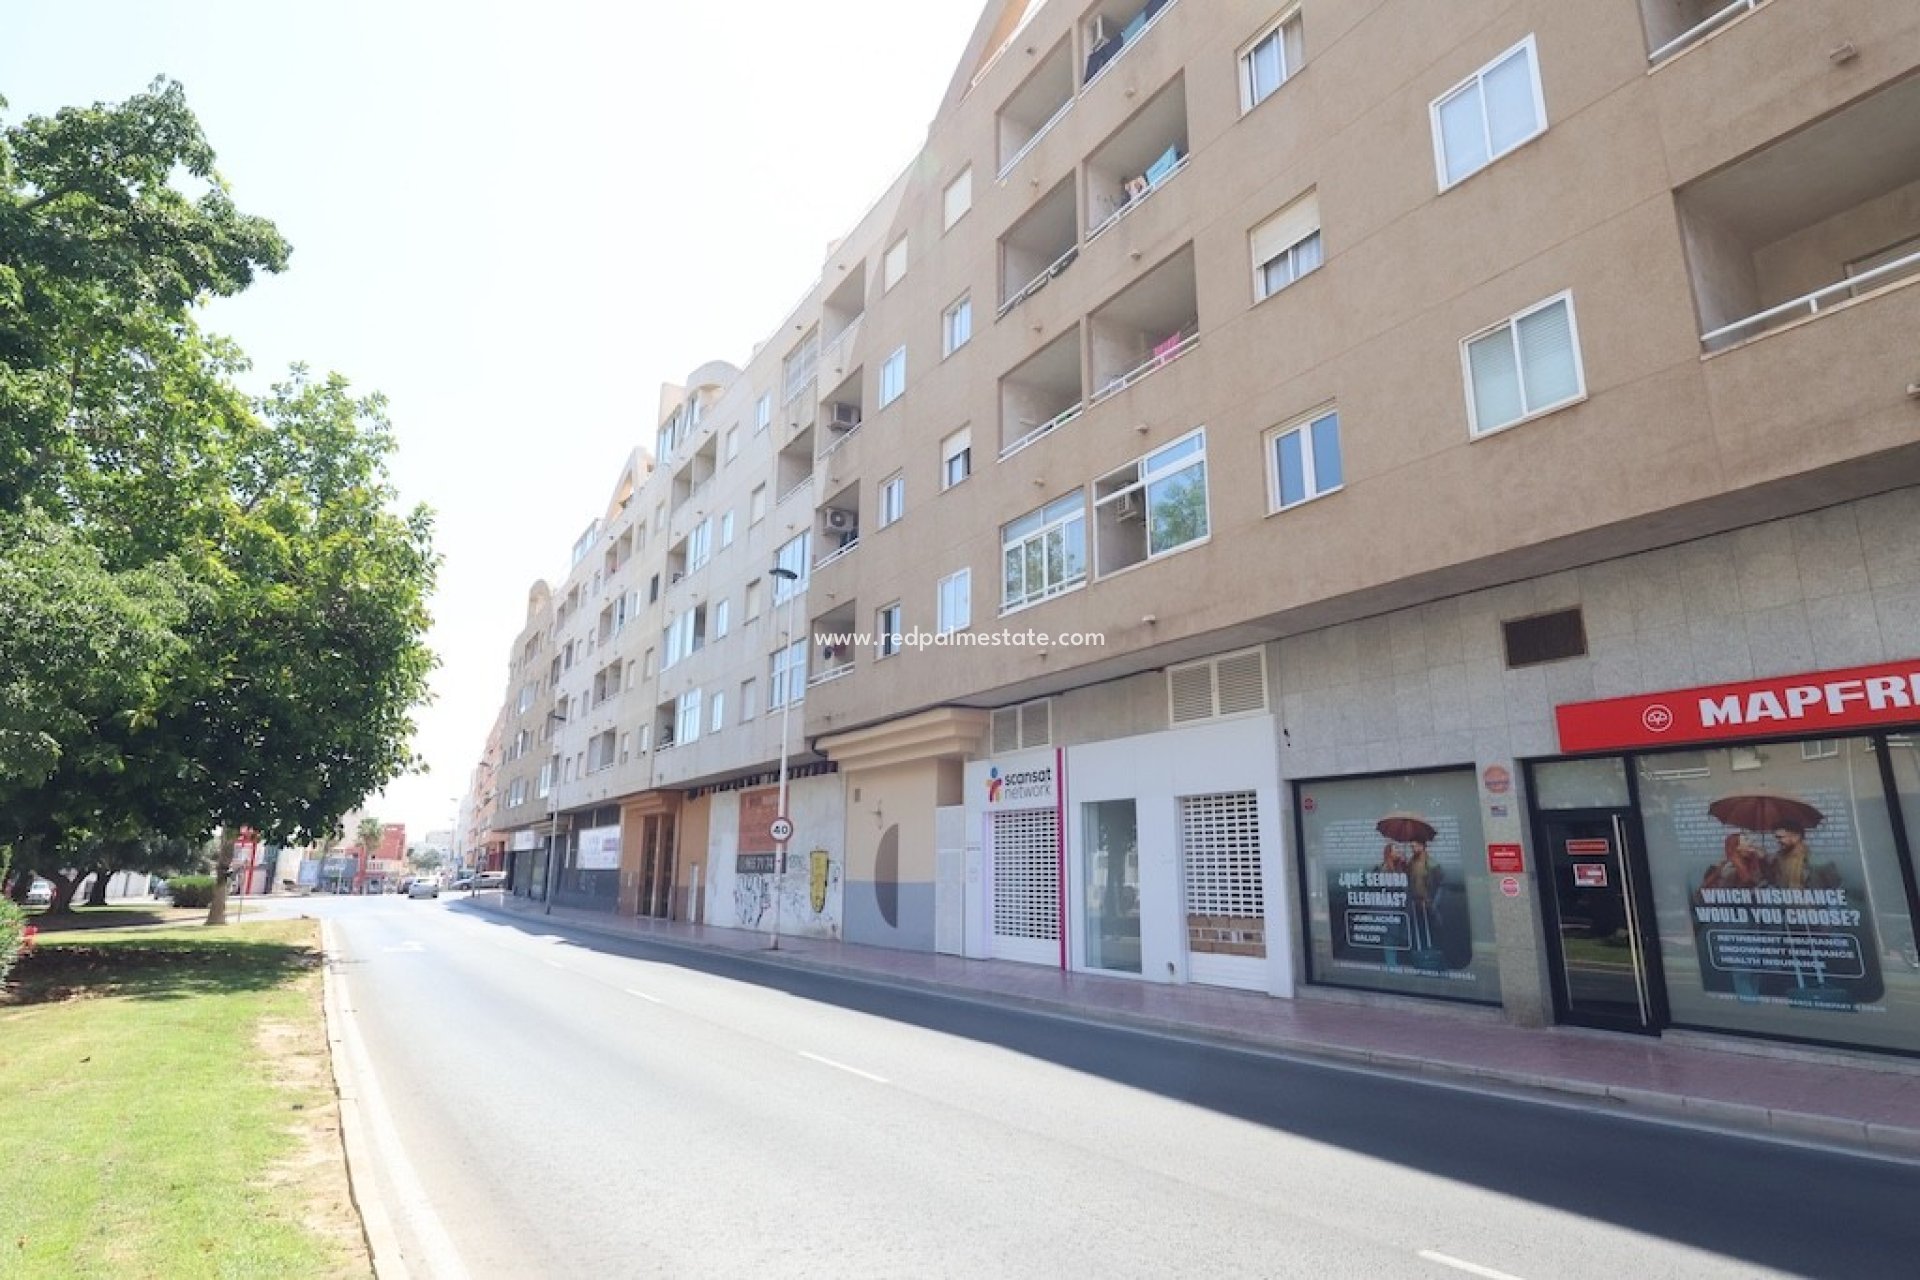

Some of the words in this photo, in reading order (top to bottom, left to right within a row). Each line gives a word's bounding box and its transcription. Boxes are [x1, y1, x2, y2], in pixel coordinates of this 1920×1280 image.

[1005, 767, 1051, 786] scansat
[1005, 785, 1051, 799] network
[773, 825, 789, 835] 40
[1366, 872, 1409, 887] SEGURO
[1701, 888, 1752, 904] WHICH
[1755, 888, 1848, 906] INSURANCE
[1695, 907, 1748, 923] WOULD
[1750, 908, 1782, 924] YOU
[1785, 909, 1861, 927] CHOOSE?
[1716, 934, 1781, 944] RETIREMENT
[1783, 936, 1849, 947] INSURANCE
[1789, 948, 1855, 959] INSURANCE
[1720, 956, 1761, 966] HEALTH
[1762, 958, 1827, 969] INSURANCE
